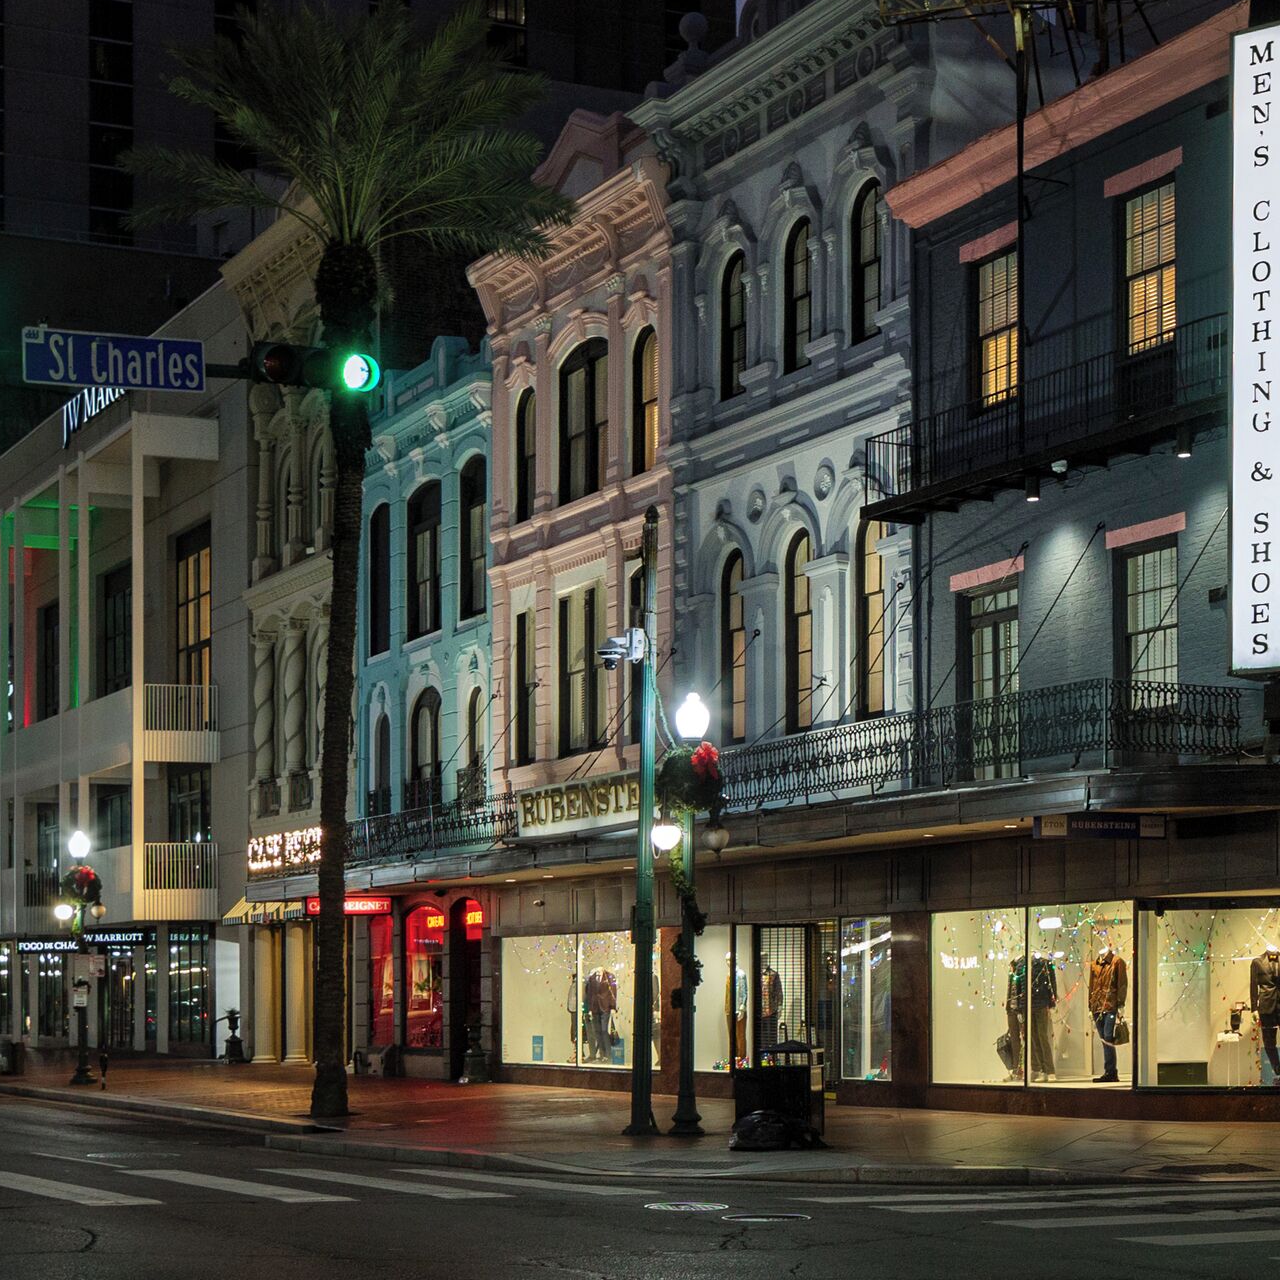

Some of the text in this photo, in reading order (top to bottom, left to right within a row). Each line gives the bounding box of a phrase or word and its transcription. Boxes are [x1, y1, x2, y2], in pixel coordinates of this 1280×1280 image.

[1249, 40, 1274, 655] MEN'S CLOTHING & SHOES
[91, 340, 200, 388] Charles
[521, 778, 640, 828] RUBENSTE
[1071, 821, 1137, 829] RUBENSTEINS
[18, 942, 43, 951] FOGO
[95, 933, 144, 942] MARRIOTT
